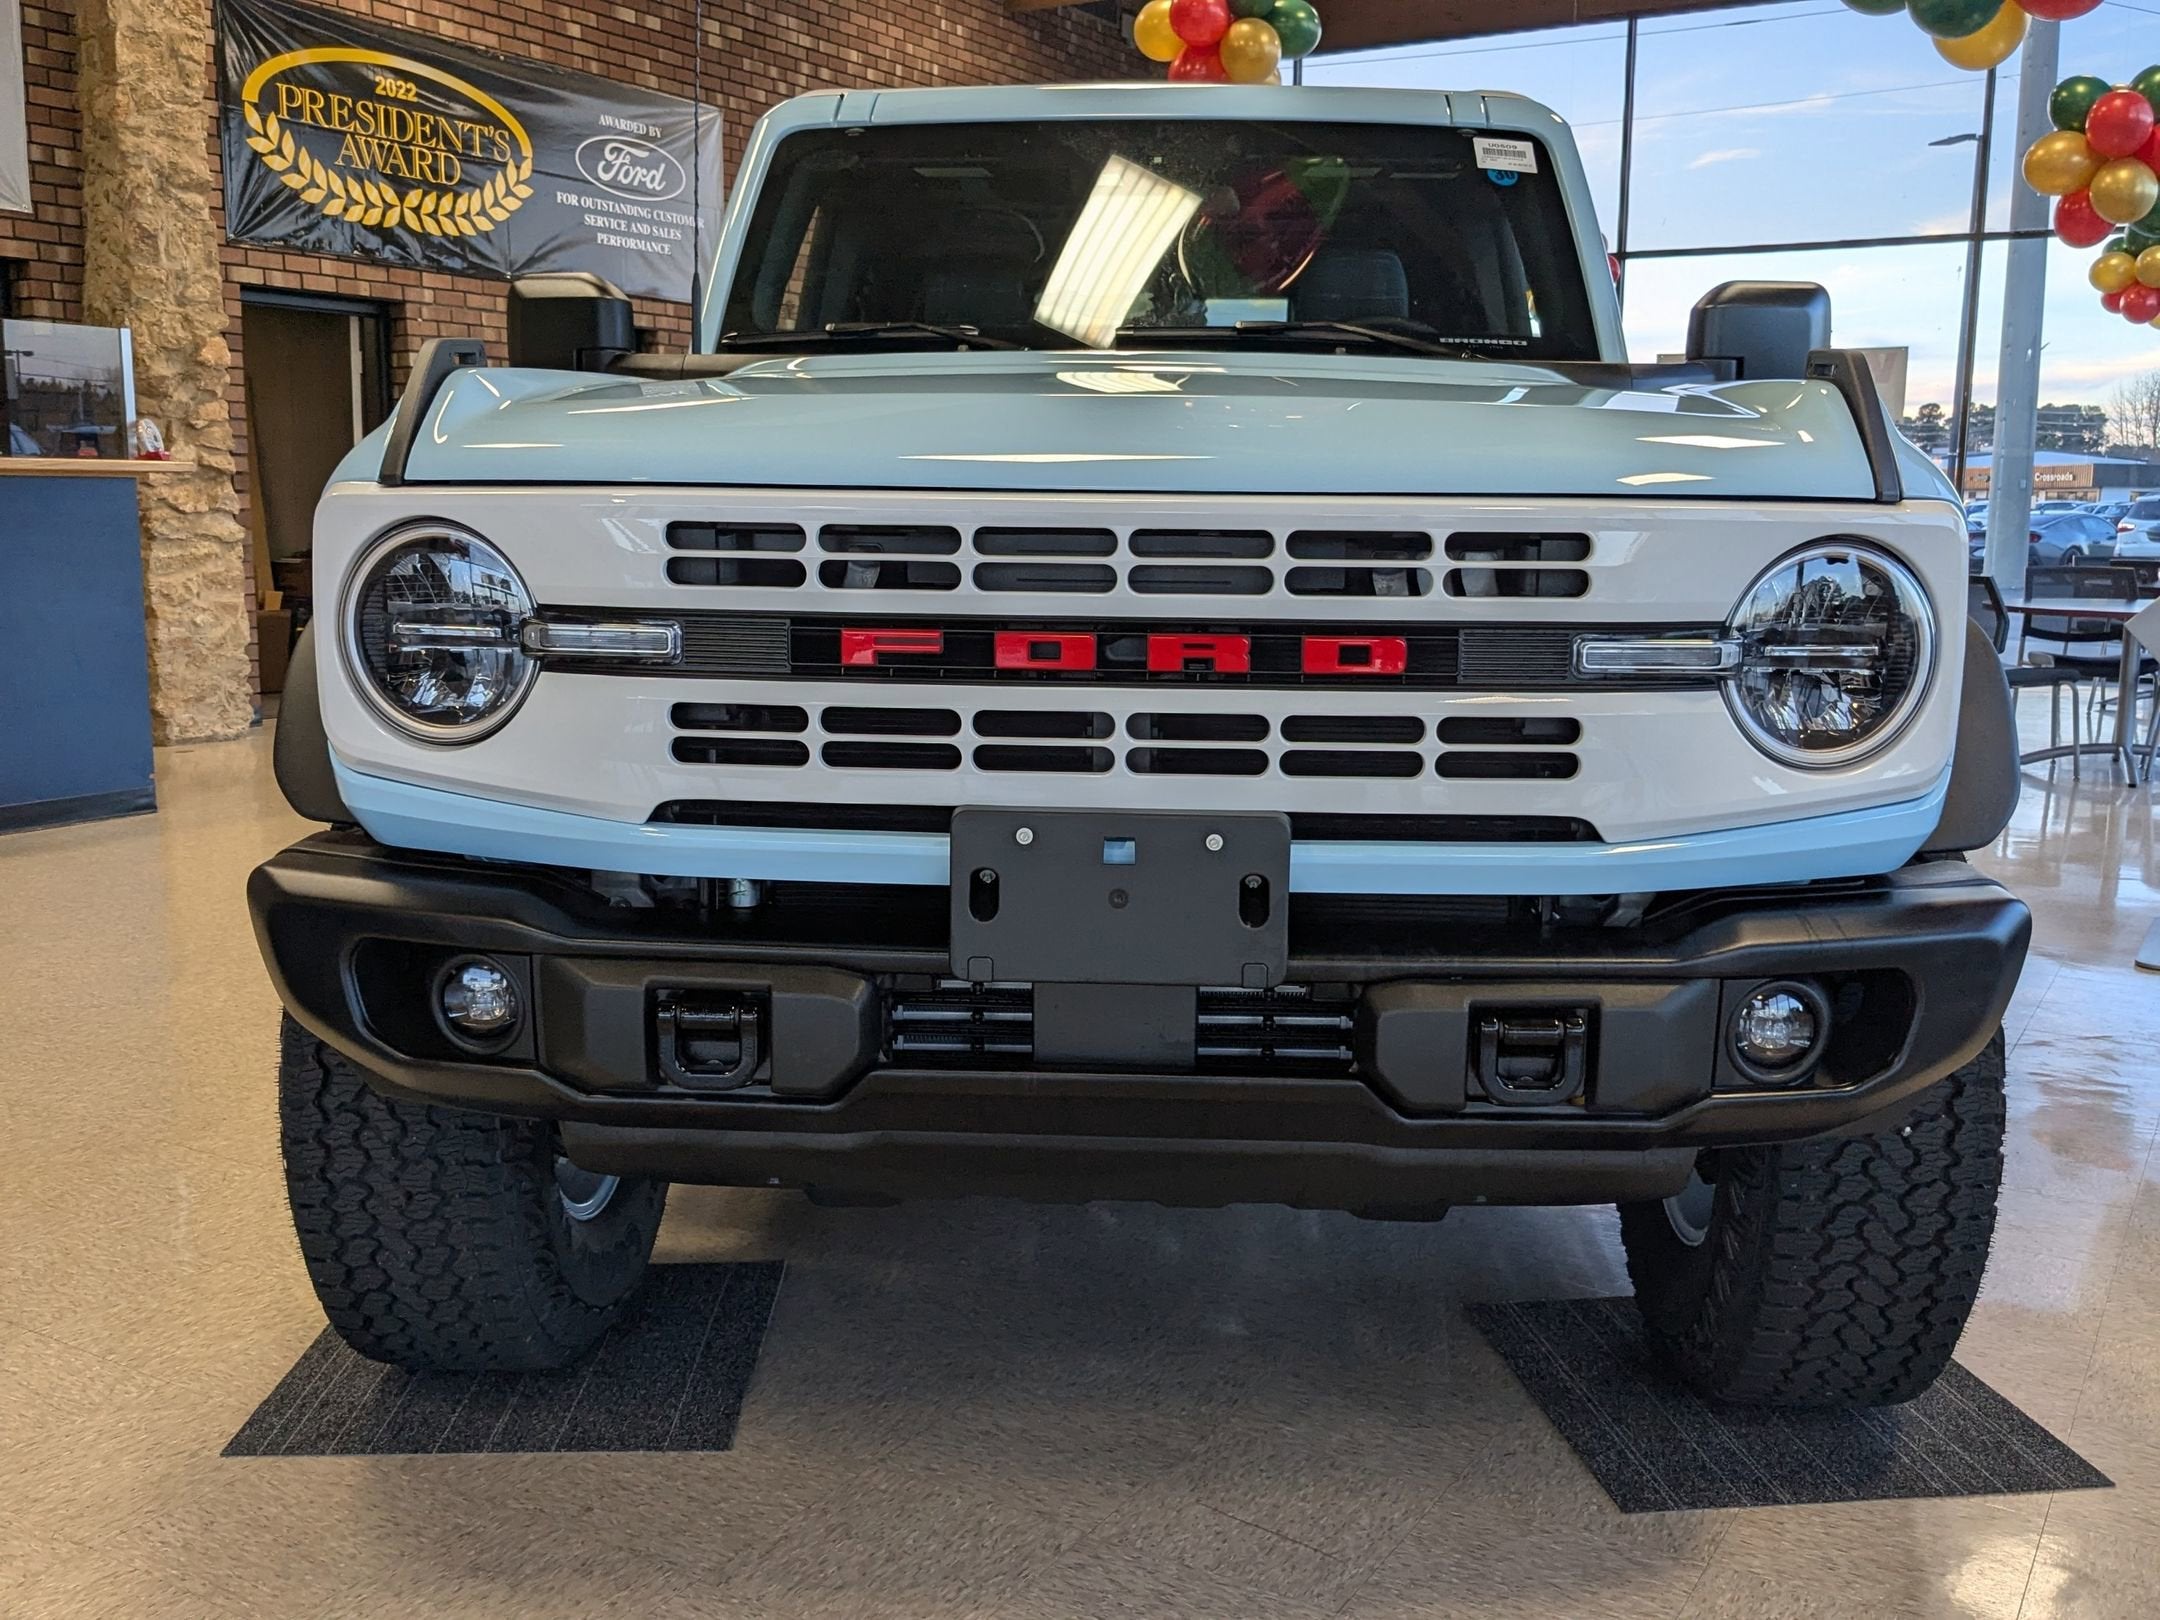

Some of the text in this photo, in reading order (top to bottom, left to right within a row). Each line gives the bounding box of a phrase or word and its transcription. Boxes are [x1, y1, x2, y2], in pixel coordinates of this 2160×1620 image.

[375, 76, 418, 101] 2022
[275, 82, 512, 163] PRESIDENT'S
[599, 114, 662, 138] AWARDED BY
[334, 133, 462, 186] AWARD
[597, 142, 667, 191] Ford
[556, 191, 705, 229] FOR OUTSTANDING CUSTOMR
[584, 214, 682, 241] SERVICE AND SALES
[597, 232, 672, 255] PERFORMANCE
[2034, 471, 2073, 482] Crossroads
[840, 628, 1408, 675] FORD
